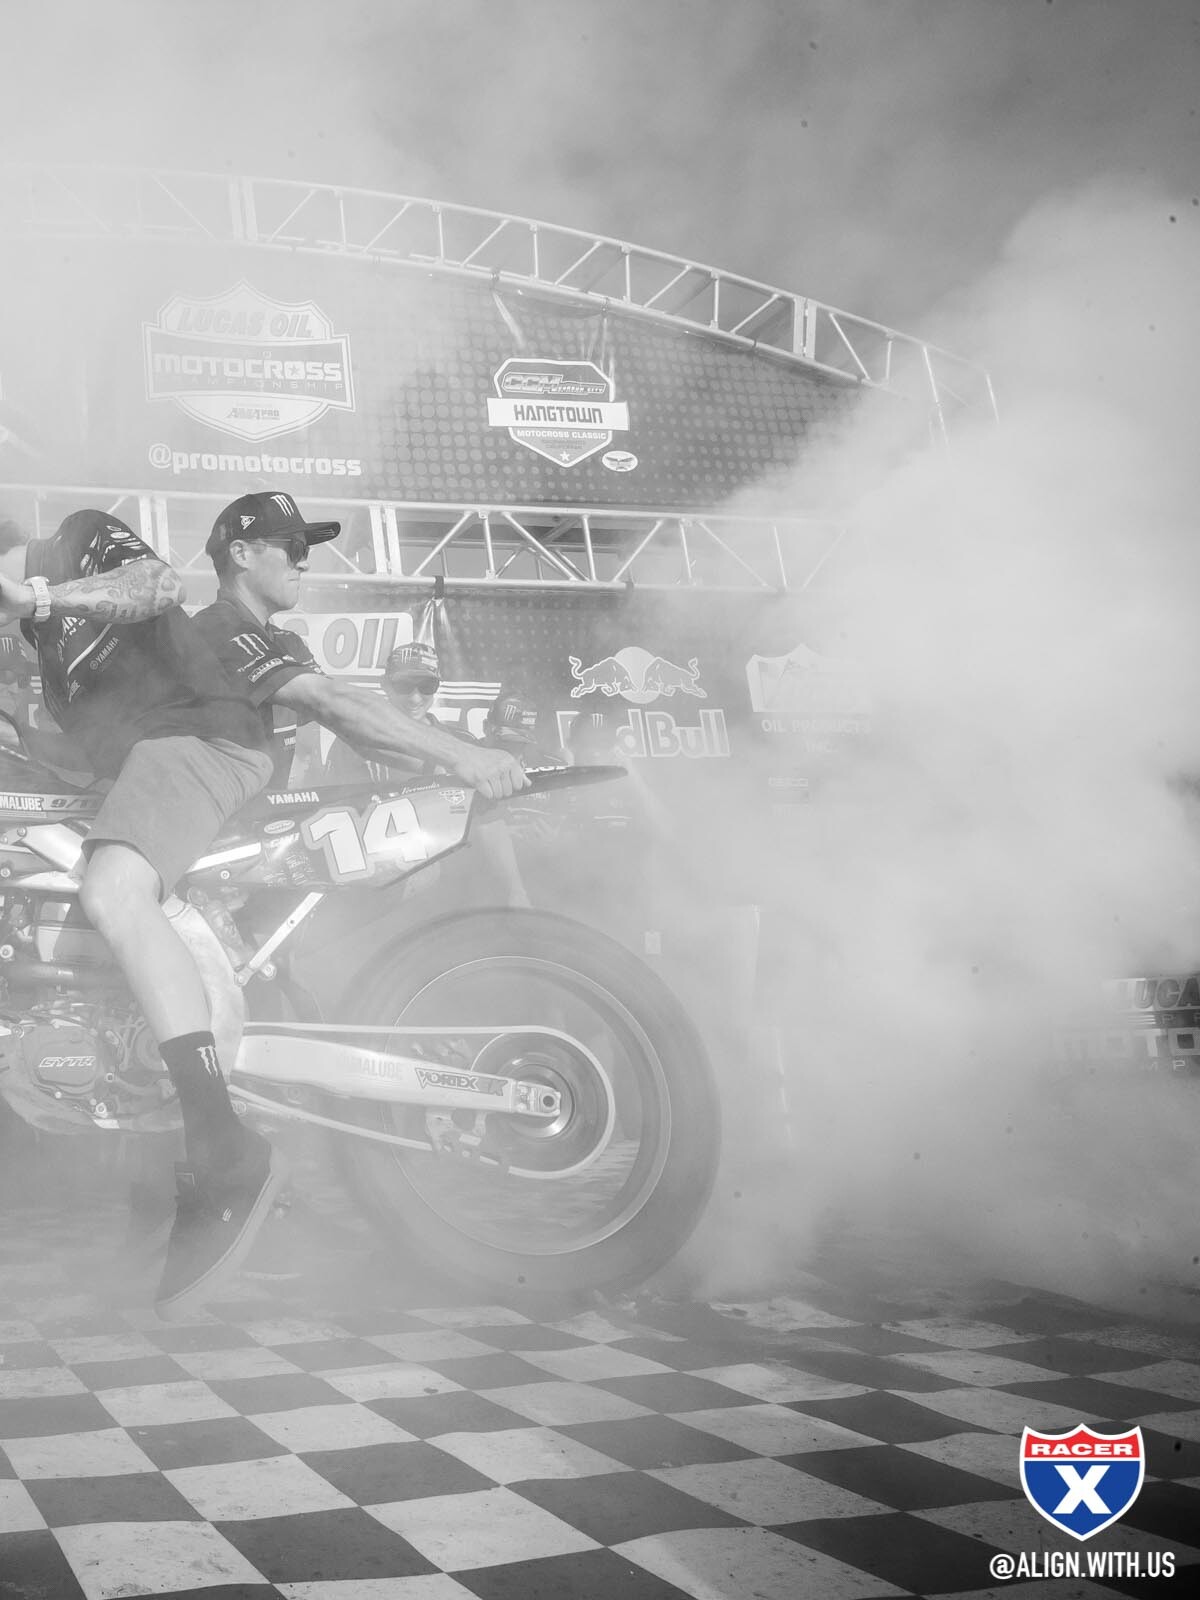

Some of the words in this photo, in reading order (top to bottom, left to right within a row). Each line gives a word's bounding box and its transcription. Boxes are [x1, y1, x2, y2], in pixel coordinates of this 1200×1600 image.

[177, 306, 265, 336] LUCAS
[270, 312, 313, 339] OIL
[152, 352, 343, 383] MOTOCROSS
[513, 404, 603, 424] HANGTOWN
[516, 429, 569, 439] MOTOCROSS
[571, 431, 607, 440] CLASSIC
[148, 441, 363, 477] @promotocross
[95, 636, 120, 664] YAMAHA
[644, 708, 731, 758] Bull
[760, 718, 788, 734] OIL
[266, 791, 320, 805] YAMAHA
[308, 798, 428, 875] 14
[416, 1067, 488, 1091] VORTEX
